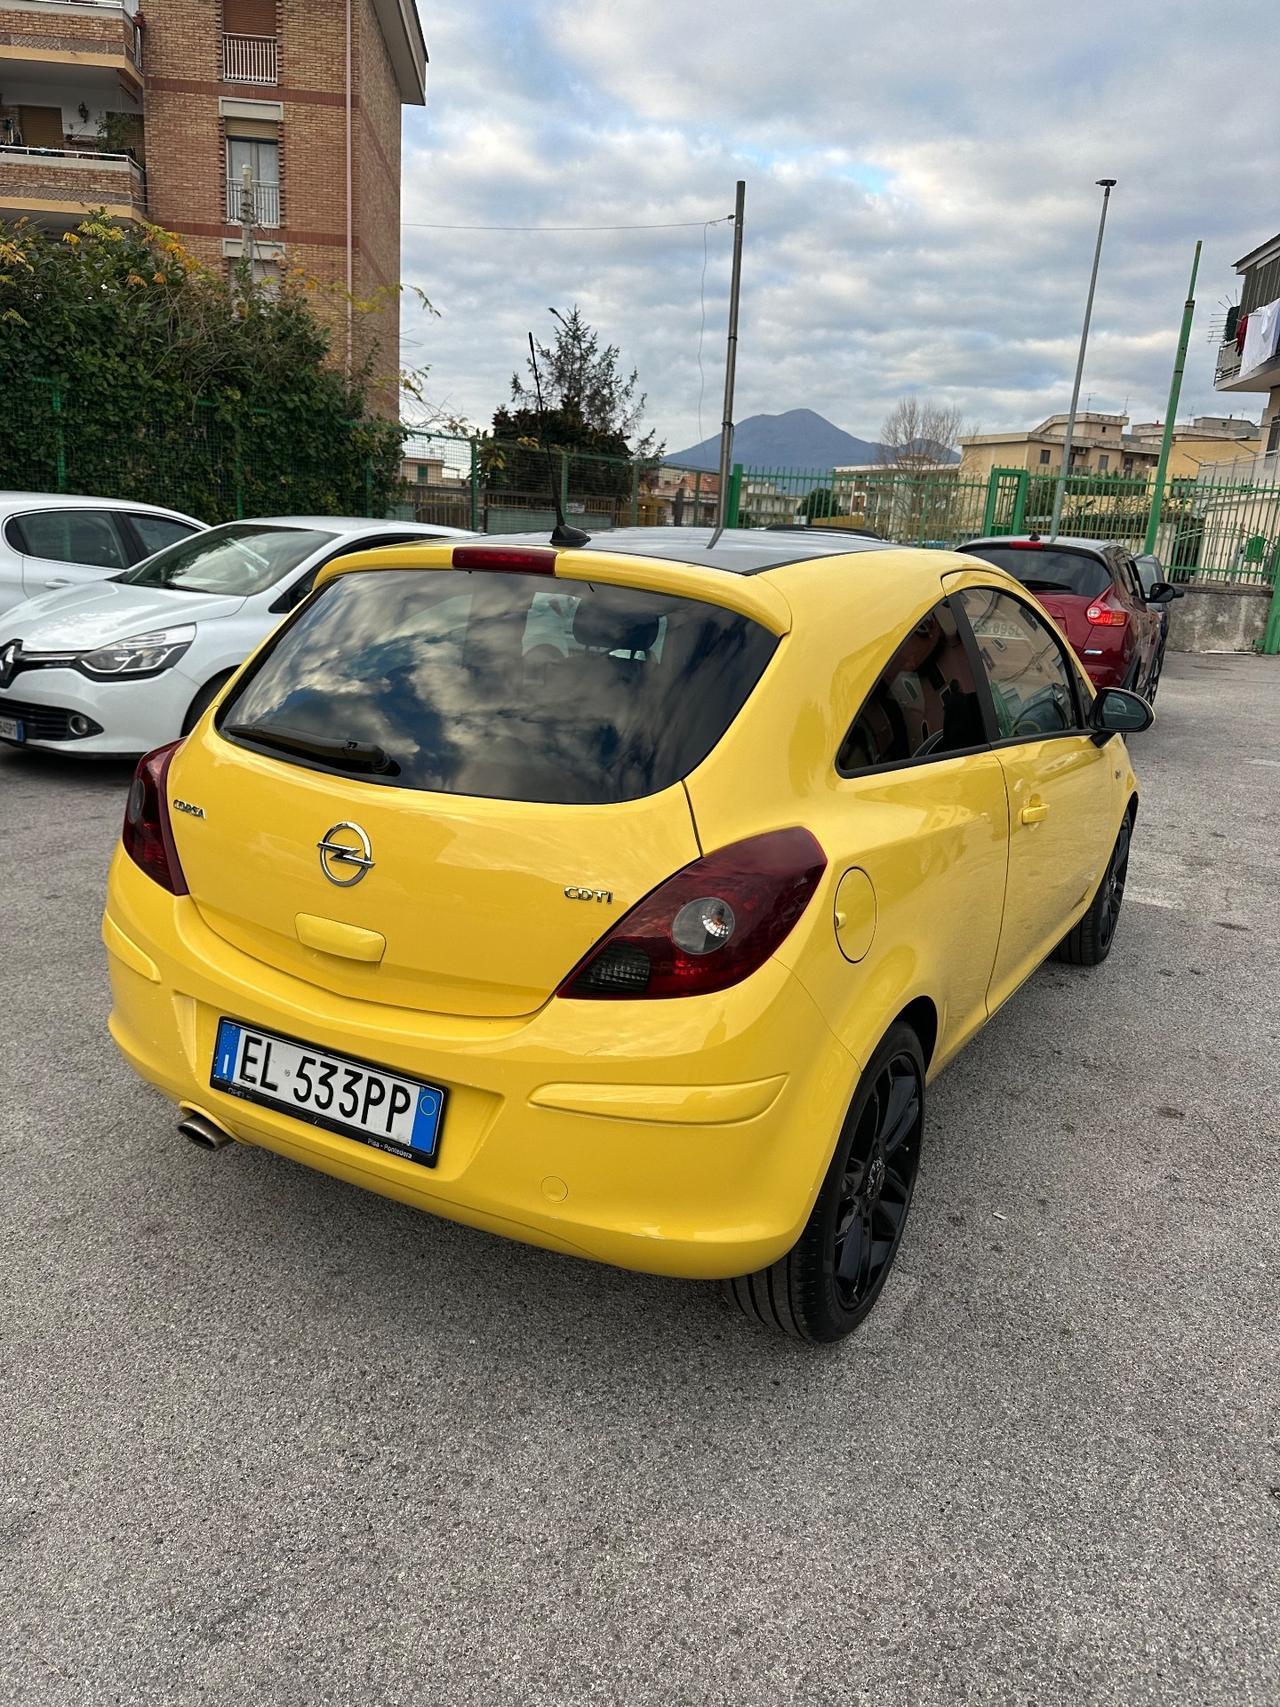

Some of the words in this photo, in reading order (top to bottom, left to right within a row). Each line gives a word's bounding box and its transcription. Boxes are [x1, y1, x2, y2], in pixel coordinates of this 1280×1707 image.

[564, 886, 613, 904] CDTI
[239, 1035, 278, 1092] EL
[293, 1055, 411, 1133] 533PP
